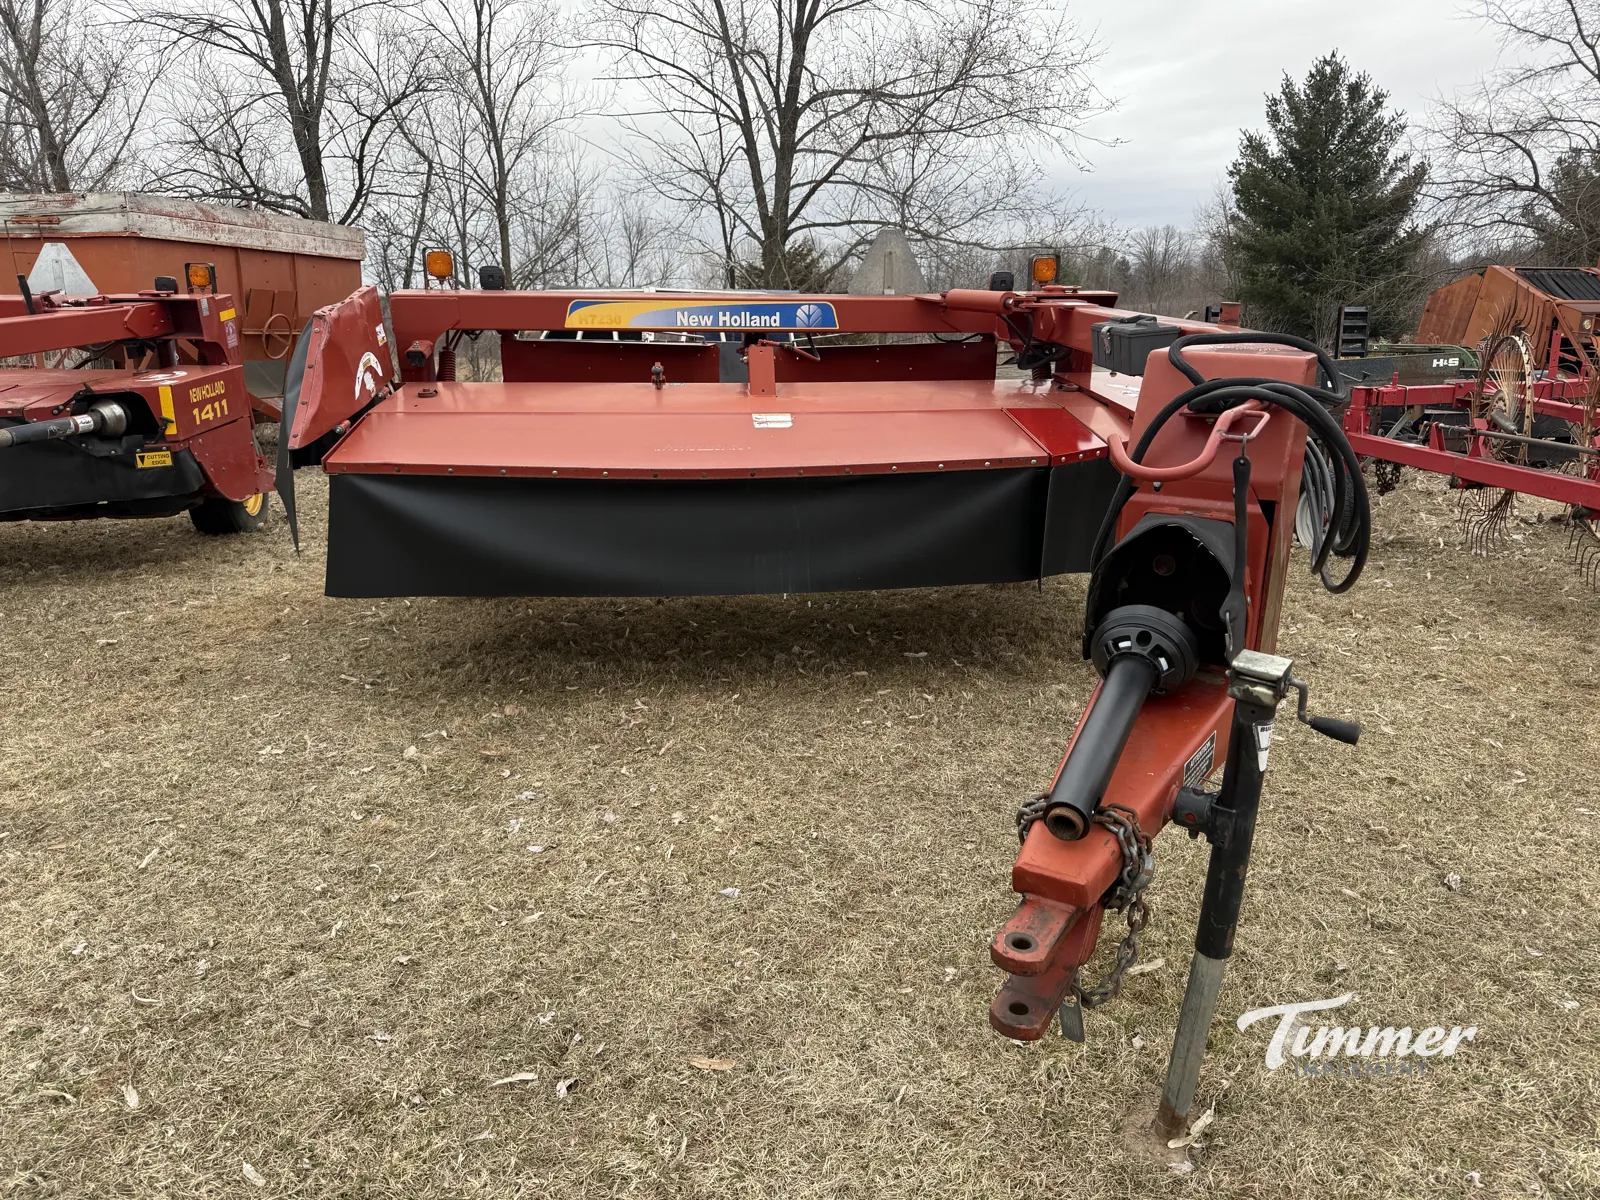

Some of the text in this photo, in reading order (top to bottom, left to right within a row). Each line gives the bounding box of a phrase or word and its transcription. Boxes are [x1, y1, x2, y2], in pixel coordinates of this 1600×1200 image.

[676, 311, 780, 327] New Holland
[1432, 357, 1459, 368] H&S
[189, 380, 226, 404] NEW HOLLAND
[192, 398, 229, 426] 1411
[146, 452, 170, 460] CUTTING
